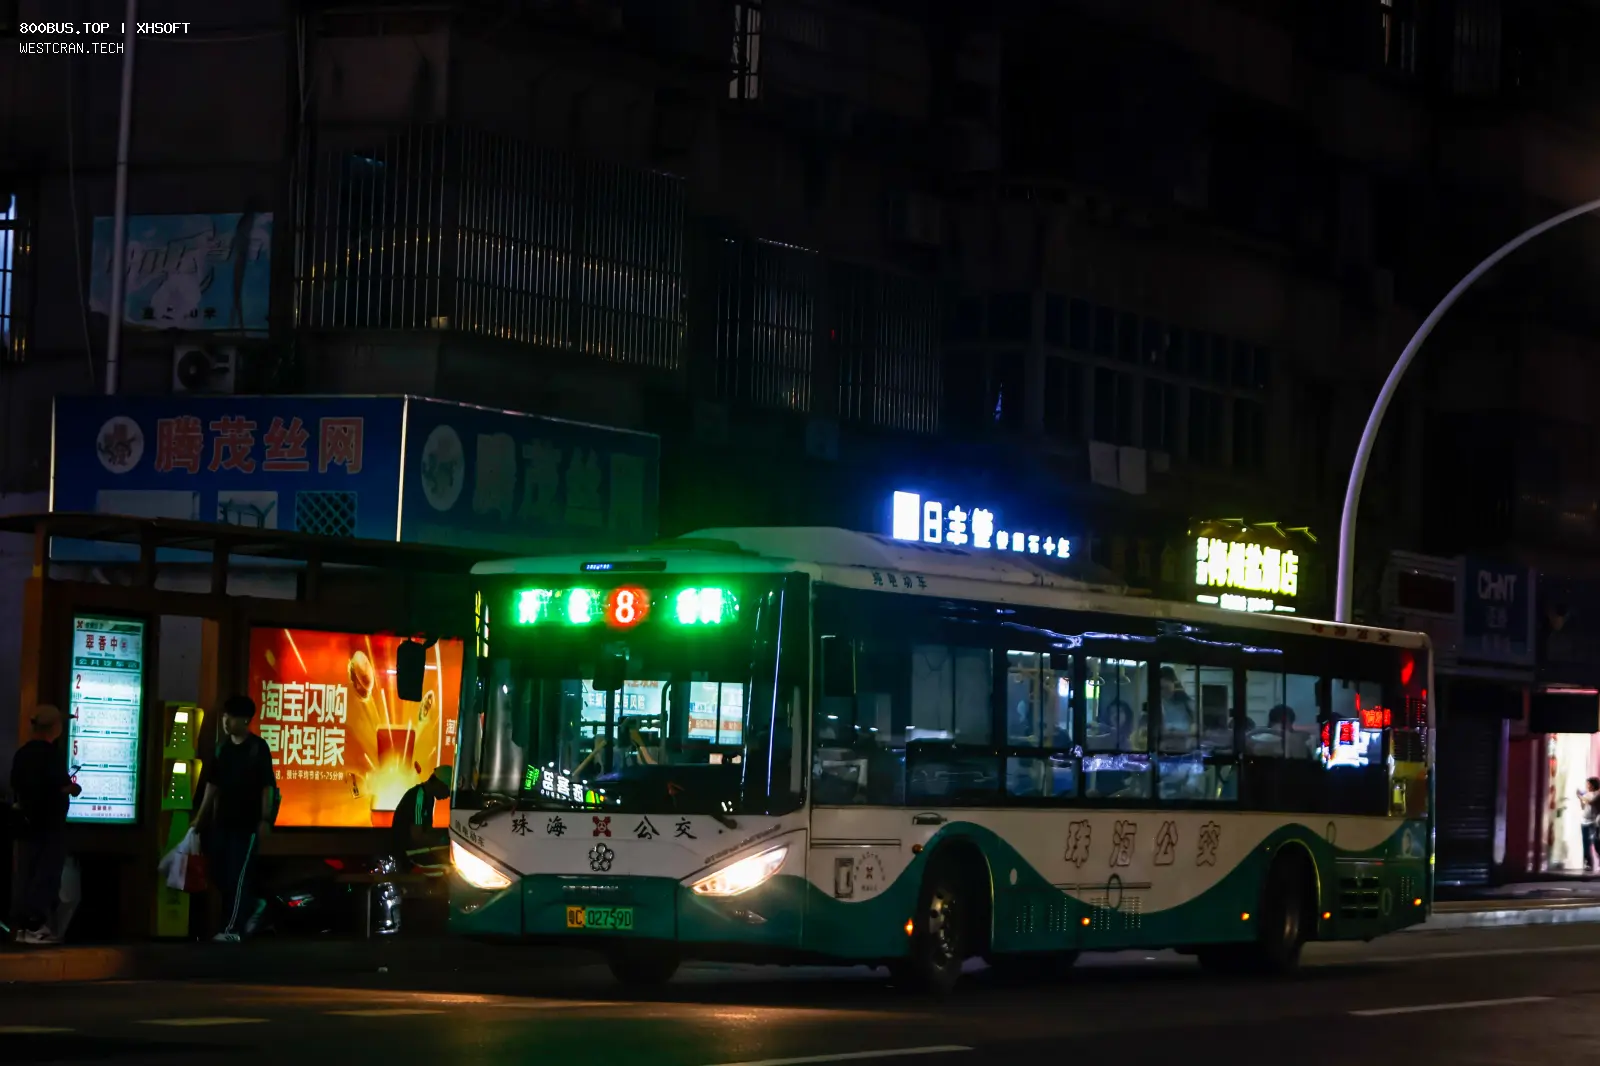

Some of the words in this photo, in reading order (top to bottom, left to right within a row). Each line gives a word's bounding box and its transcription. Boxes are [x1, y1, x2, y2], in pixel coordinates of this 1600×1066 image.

[154, 415, 364, 475] 腾茂丝网
[615, 590, 635, 624] 8
[75, 673, 82, 690] 2
[259, 680, 348, 724] 淘宝闪购
[72, 740, 79, 756] 5
[259, 724, 345, 767] 更快到家
[511, 814, 568, 838] 珠海
[633, 814, 698, 840] 公交
[1065, 819, 1222, 868] 珠海公交
